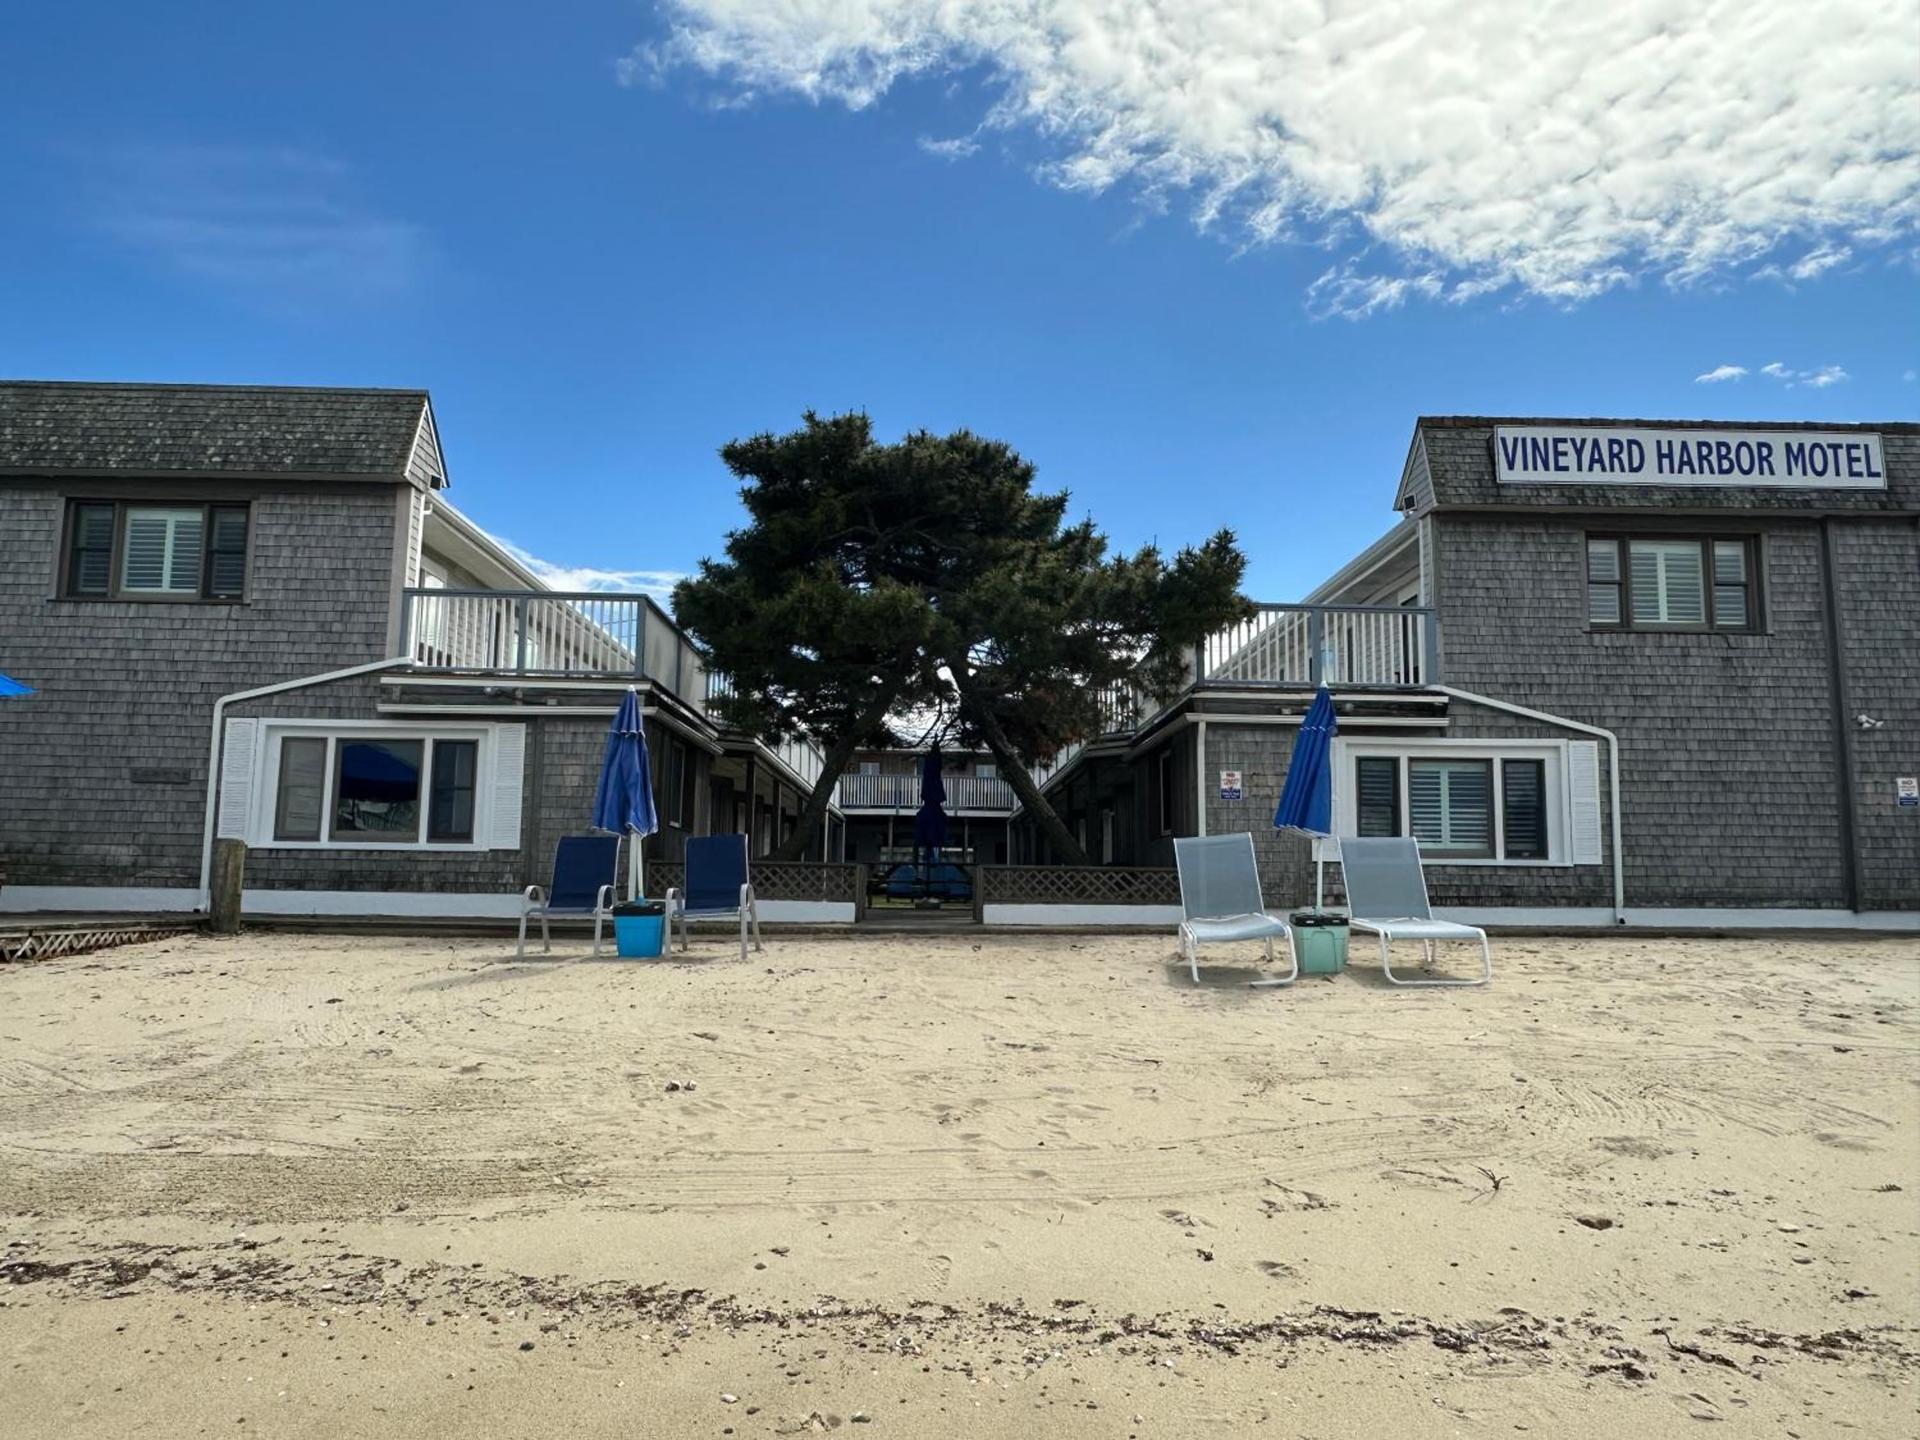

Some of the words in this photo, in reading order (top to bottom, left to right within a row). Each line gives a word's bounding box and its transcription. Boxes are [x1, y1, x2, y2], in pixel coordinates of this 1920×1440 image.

[1500, 436, 1645, 473] VINEYARD
[1656, 440, 1775, 476] HARBOR
[1785, 442, 1882, 478] MOTEL
